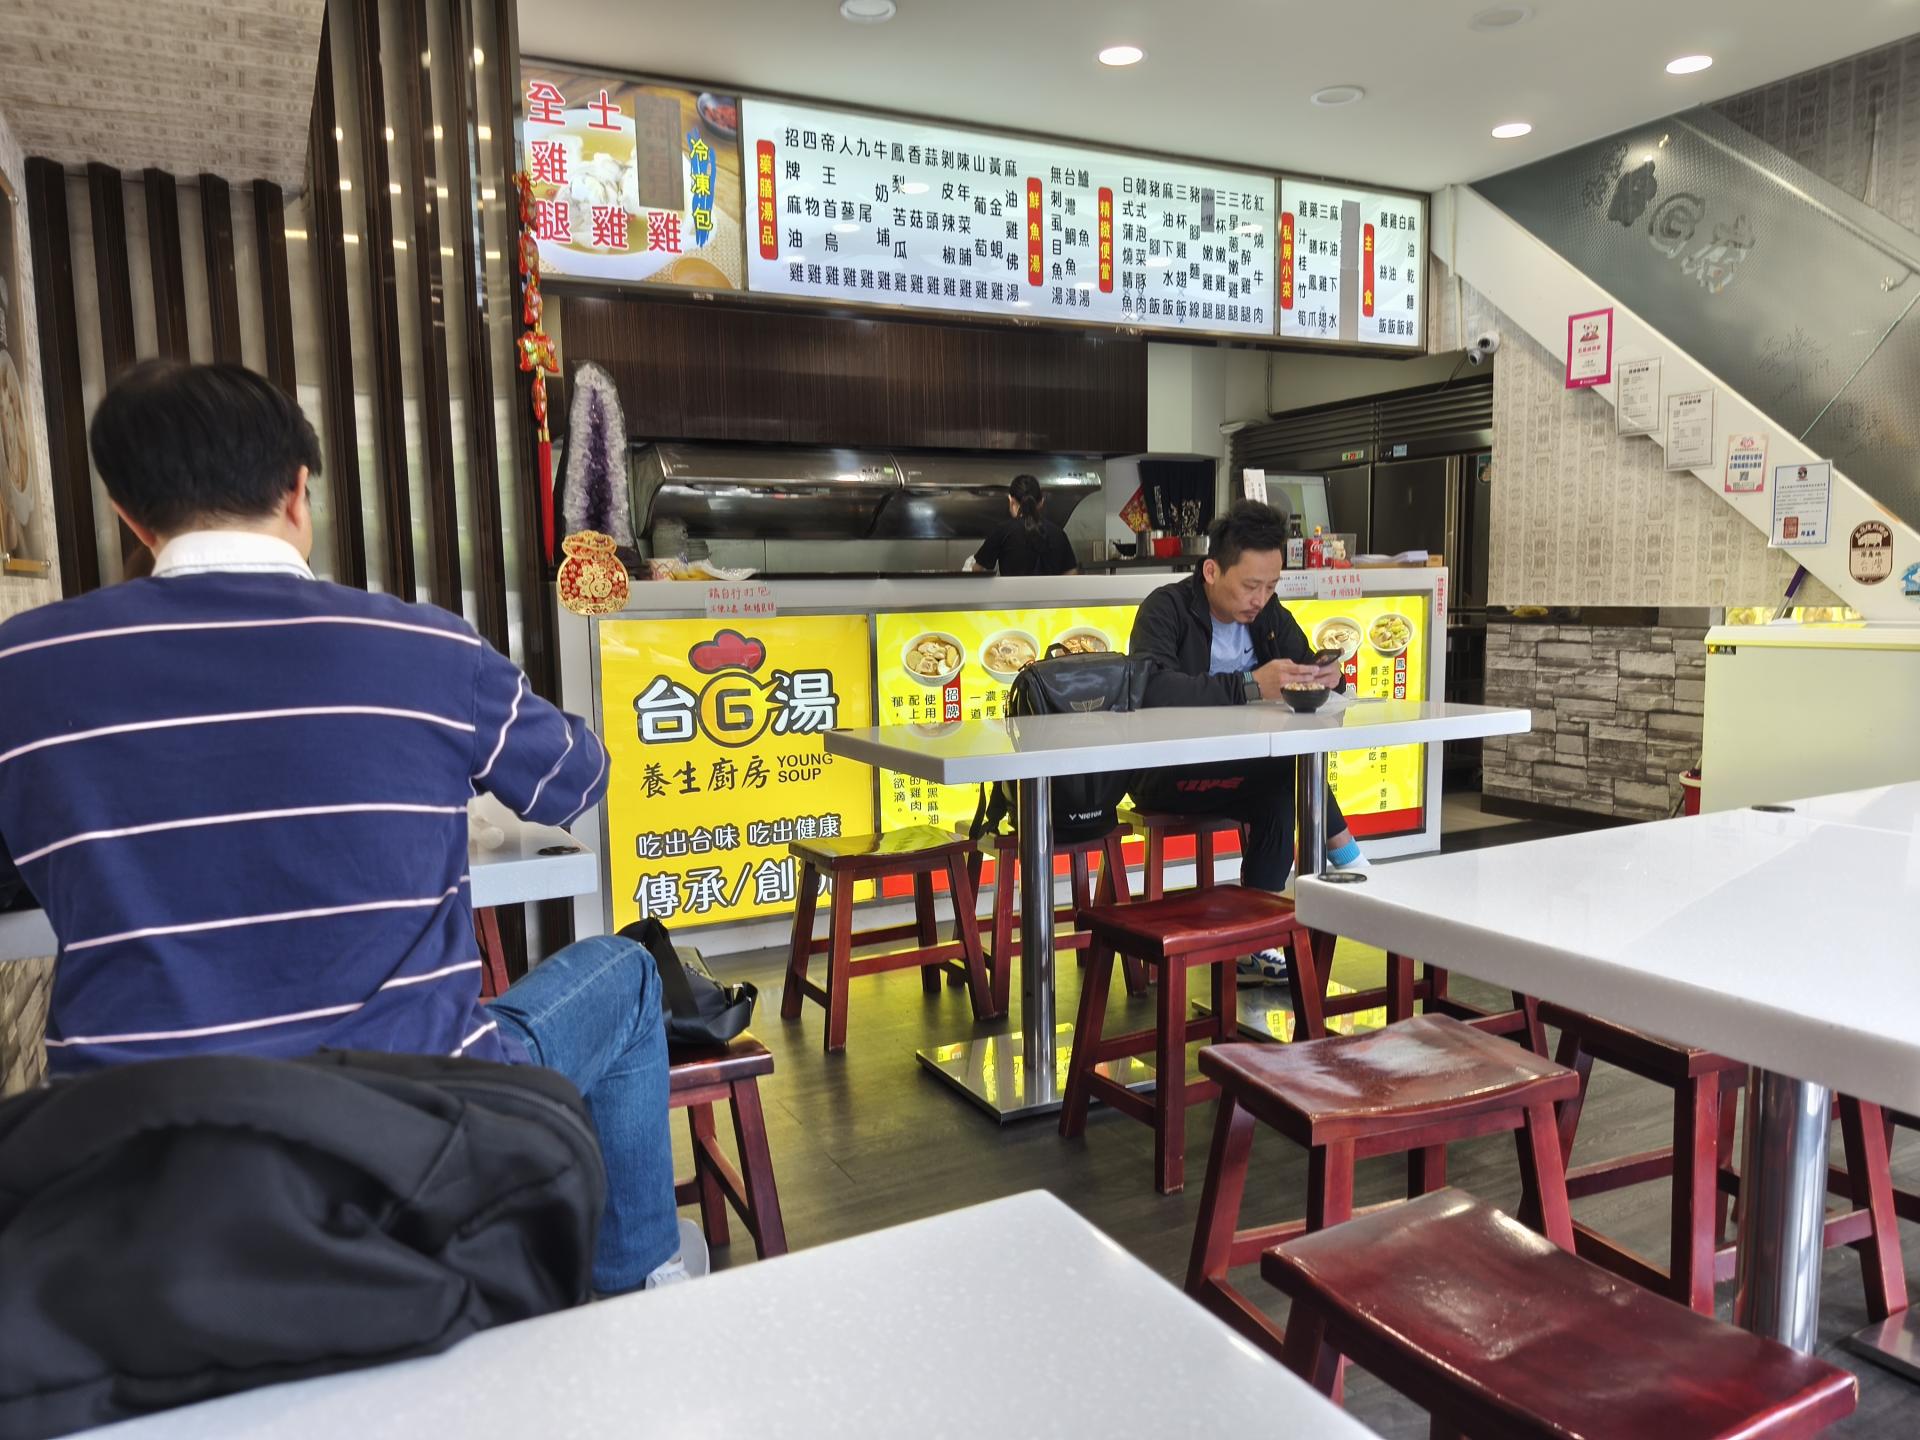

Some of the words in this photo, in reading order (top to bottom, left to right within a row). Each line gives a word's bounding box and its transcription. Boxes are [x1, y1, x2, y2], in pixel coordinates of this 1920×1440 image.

[689, 138, 713, 232] 冷凍包
[759, 154, 774, 246] 藥膳湯品
[786, 127, 803, 283] 招牌麻油雞
[803, 131, 821, 285] 四物雞
[821, 133, 839, 286] 帝王首烏雞
[856, 137, 874, 289] 九尾雞
[874, 140, 891, 291] 牛奶埔雞
[891, 142, 907, 293] 鳳梨苦瓜雞
[908, 145, 923, 294] 香菇雞
[925, 147, 940, 296] 蒜頭雞
[957, 151, 973, 298] 陳年菜脯雞
[973, 154, 988, 300] 山葡萄雞
[1004, 159, 1019, 303] 麻油雞佛湯
[1029, 191, 1040, 272] 鮮魚湯
[1051, 166, 1063, 304] 無刺虱目魚湯
[1064, 168, 1077, 306] 台灣鯛魚湯
[1078, 169, 1090, 308] 鱸魚湯
[1100, 202, 1110, 280] 精緻便當
[1135, 178, 1147, 313] 韓式泡菜豚肉
[1162, 182, 1174, 317] 麻油下水飯
[1176, 184, 1187, 317] 三杯雞翅飯
[1215, 190, 1226, 320] 三杯嫩雞腿
[1254, 196, 1265, 324] 紅燒牛肉
[1282, 225, 1292, 299] 私房小菜
[1308, 202, 1318, 328] 藥膳鳳爪
[1318, 204, 1328, 328] 三杯雞翅
[1329, 205, 1338, 328] 麻油下水
[1365, 236, 1372, 305] 主食
[640, 755, 771, 799] 養生廚房
[777, 752, 834, 768] YOUNG
[778, 767, 822, 783] SOUP
[927, 780, 939, 825] 黑麻油
[637, 824, 739, 859] 吃出台味
[748, 813, 841, 846] 吃出健康
